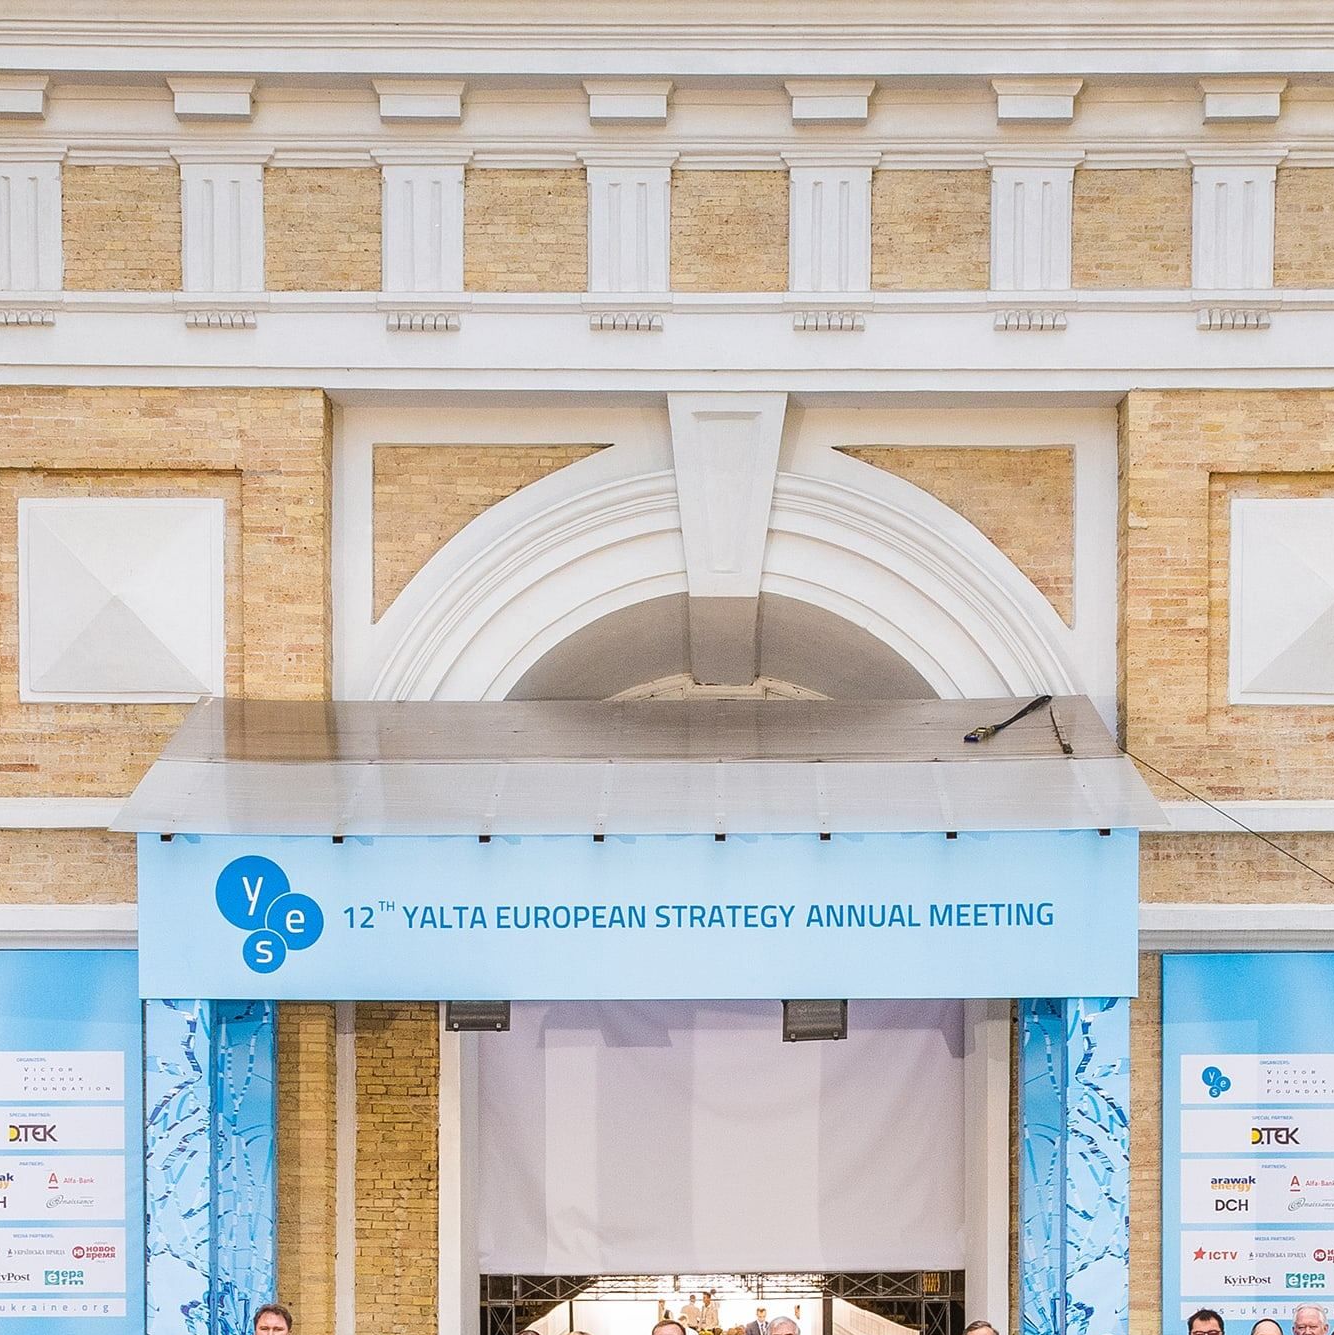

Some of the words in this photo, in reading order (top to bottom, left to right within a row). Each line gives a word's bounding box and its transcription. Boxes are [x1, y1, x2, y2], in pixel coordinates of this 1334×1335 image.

[402, 905, 487, 929] YALTA
[496, 905, 646, 928] EUROPEAN
[655, 904, 795, 928] STRATEGY
[806, 903, 921, 927] ANNUAL
[929, 902, 1054, 926] MEETING
[1210, 1175, 1256, 1184] arawak
[1211, 1184, 1252, 1192] energy
[1215, 1199, 1249, 1212] DCH
[1209, 1251, 1238, 1260] ICTV
[1224, 1275, 1271, 1286] KyivPost
